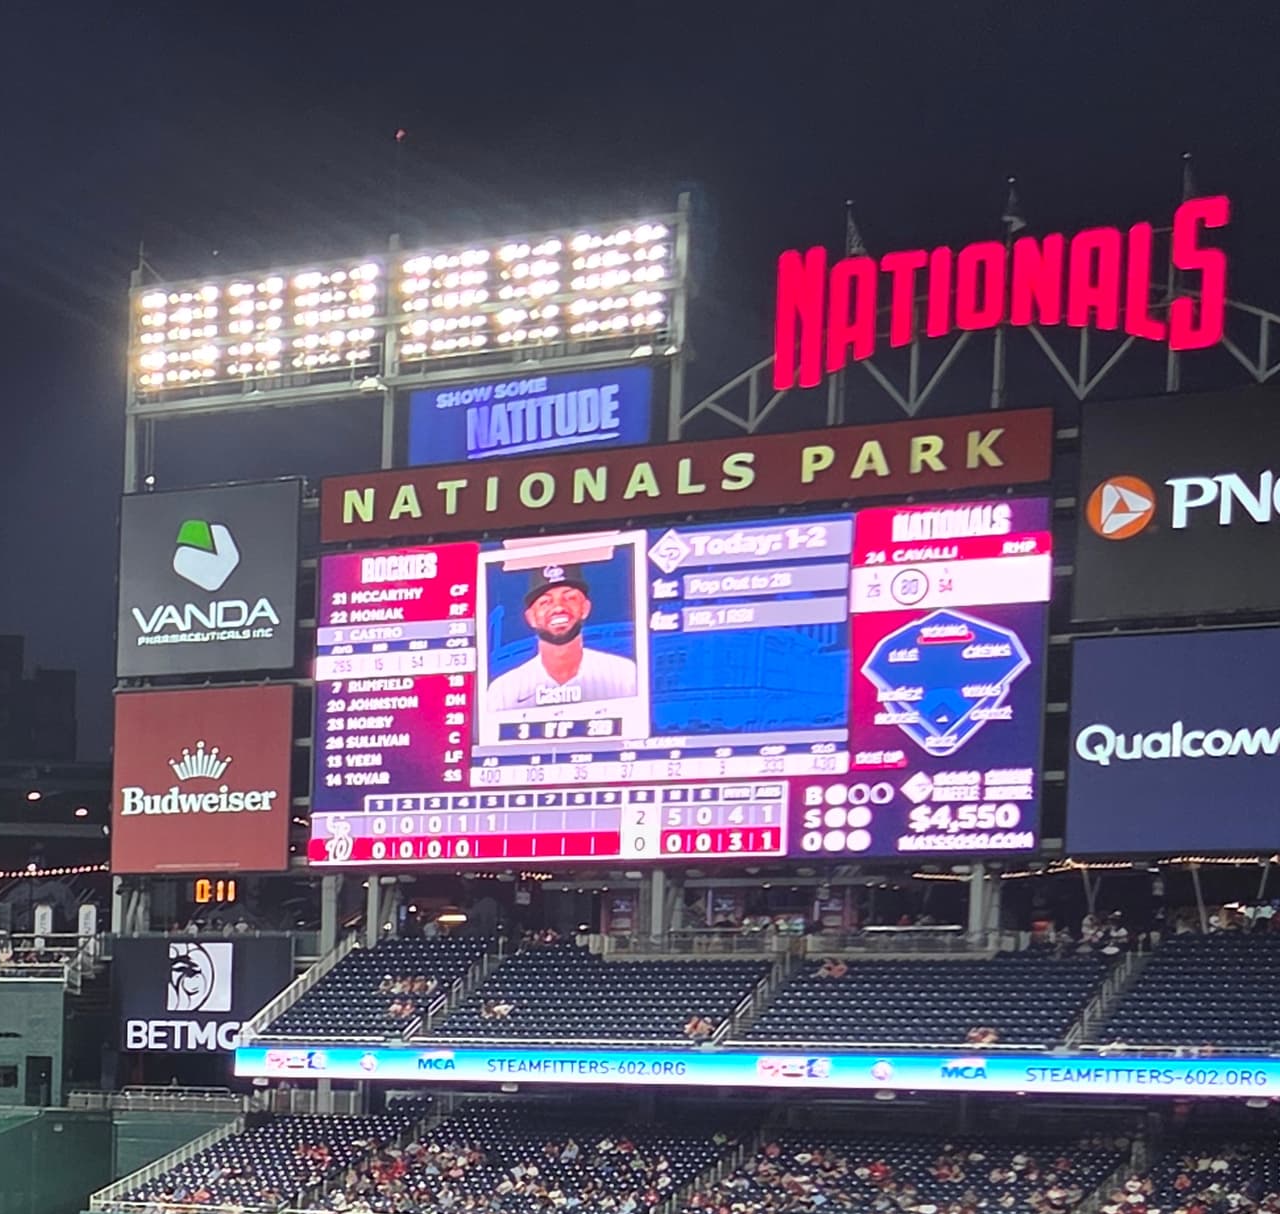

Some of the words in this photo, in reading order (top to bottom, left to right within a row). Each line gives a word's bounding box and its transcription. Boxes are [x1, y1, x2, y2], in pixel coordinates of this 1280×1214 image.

[774, 195, 1229, 390] NATIONALS
[436, 382, 489, 408] SHOW
[496, 377, 547, 397] SOME
[467, 384, 619, 450] NATITUDE
[343, 453, 756, 524] NATIONALS
[801, 428, 1005, 483] PARK
[1165, 470, 1280, 529] PN
[892, 503, 1011, 542] NATIONALS
[690, 532, 783, 556] Today:
[785, 526, 828, 550] 1-2
[892, 545, 958, 563] CAVALLI
[362, 553, 437, 583] ROCKIES
[351, 588, 422, 603] MCCARTHY
[451, 584, 468, 596] CF
[690, 579, 720, 594] Pop
[721, 576, 750, 591] Out
[751, 576, 769, 589] to
[132, 598, 280, 633] VANDA
[331, 611, 347, 624] 22
[350, 608, 403, 622] MONIAK
[450, 604, 467, 615] RF
[137, 630, 251, 646] PHARMACEUTICALS
[253, 628, 273, 638] INC
[350, 627, 402, 641] CASTRO
[332, 681, 342, 693] 7
[326, 700, 345, 712] 20
[347, 696, 418, 711] JOHNSTON
[346, 734, 409, 748] SULLIVAN
[449, 732, 460, 743] C
[1075, 720, 1280, 766] Qualcom
[346, 753, 381, 766] VEEN
[445, 750, 463, 762] LF
[326, 774, 341, 786] 14
[345, 772, 390, 785] TOVAR
[444, 769, 461, 781] SS
[121, 786, 278, 815] Budweiser
[805, 786, 822, 805] B
[373, 817, 386, 834] 0
[401, 816, 414, 834] 0
[428, 816, 442, 833] 0
[458, 815, 467, 832] 1
[487, 814, 496, 831] 1
[636, 811, 645, 825] 2
[667, 809, 682, 825] 5
[697, 807, 711, 825] 0
[728, 806, 744, 824] 4
[762, 805, 773, 823] 1
[804, 808, 822, 829] S
[909, 803, 1020, 833] $4,550
[372, 841, 386, 859] 0
[399, 841, 414, 859] 0
[427, 840, 442, 858] 0
[455, 840, 469, 857] 0
[635, 837, 645, 850] 0
[666, 834, 682, 852] 0
[696, 833, 711, 851] 0
[728, 833, 743, 850] 3
[761, 832, 772, 850] 1
[195, 879, 236, 902] 0:11
[126, 1020, 252, 1050] BETMG
[418, 1059, 455, 1070] MCA
[487, 1058, 686, 1075] STEAMFITTERS-602.ORG
[941, 1066, 987, 1079] MCA
[1025, 1067, 1267, 1086] STEAMFITTERS-602.ORG
